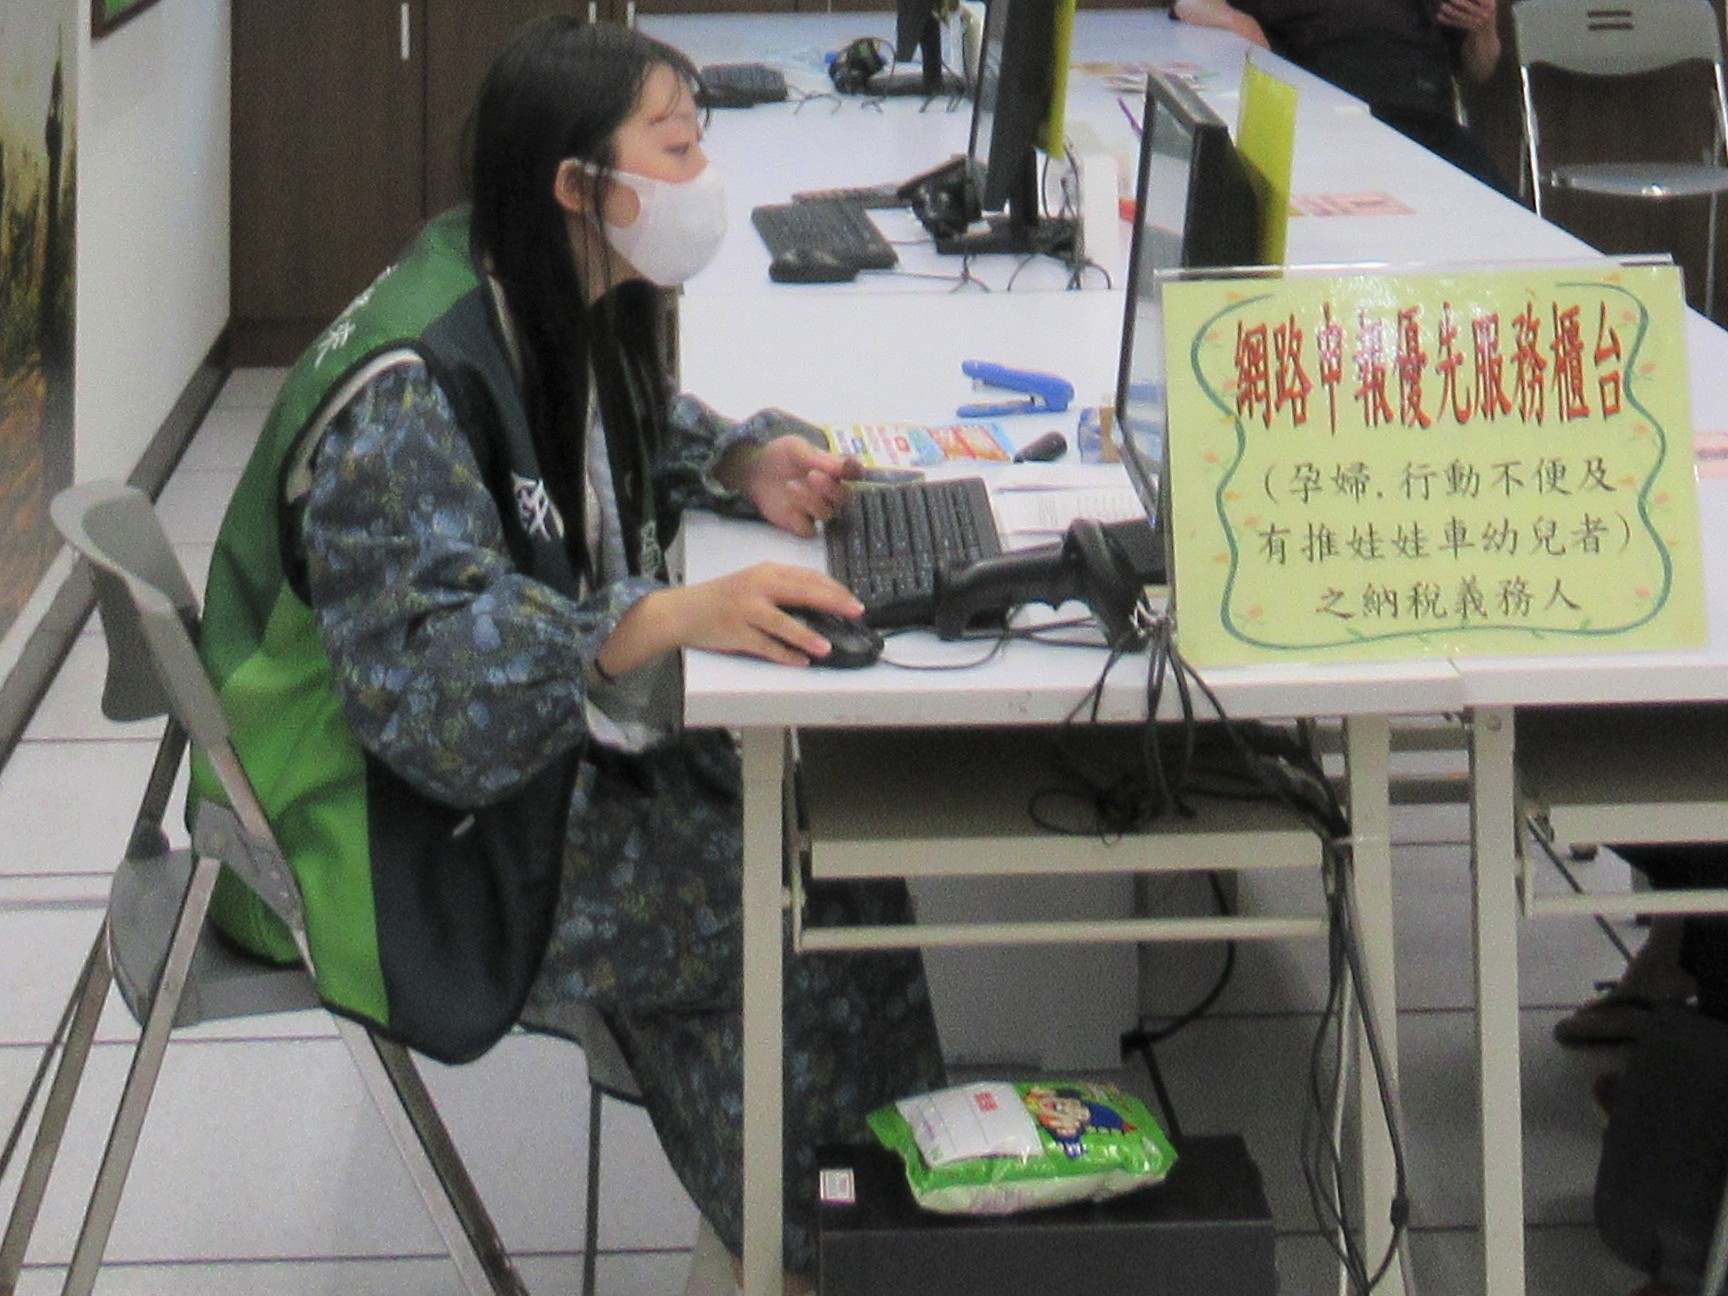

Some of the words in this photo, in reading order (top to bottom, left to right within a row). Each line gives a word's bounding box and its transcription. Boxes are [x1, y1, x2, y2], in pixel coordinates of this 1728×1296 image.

[1233, 300, 1624, 435] 網路申報優先服務櫃台
[1314, 574, 1582, 622] 之納稅義務人
